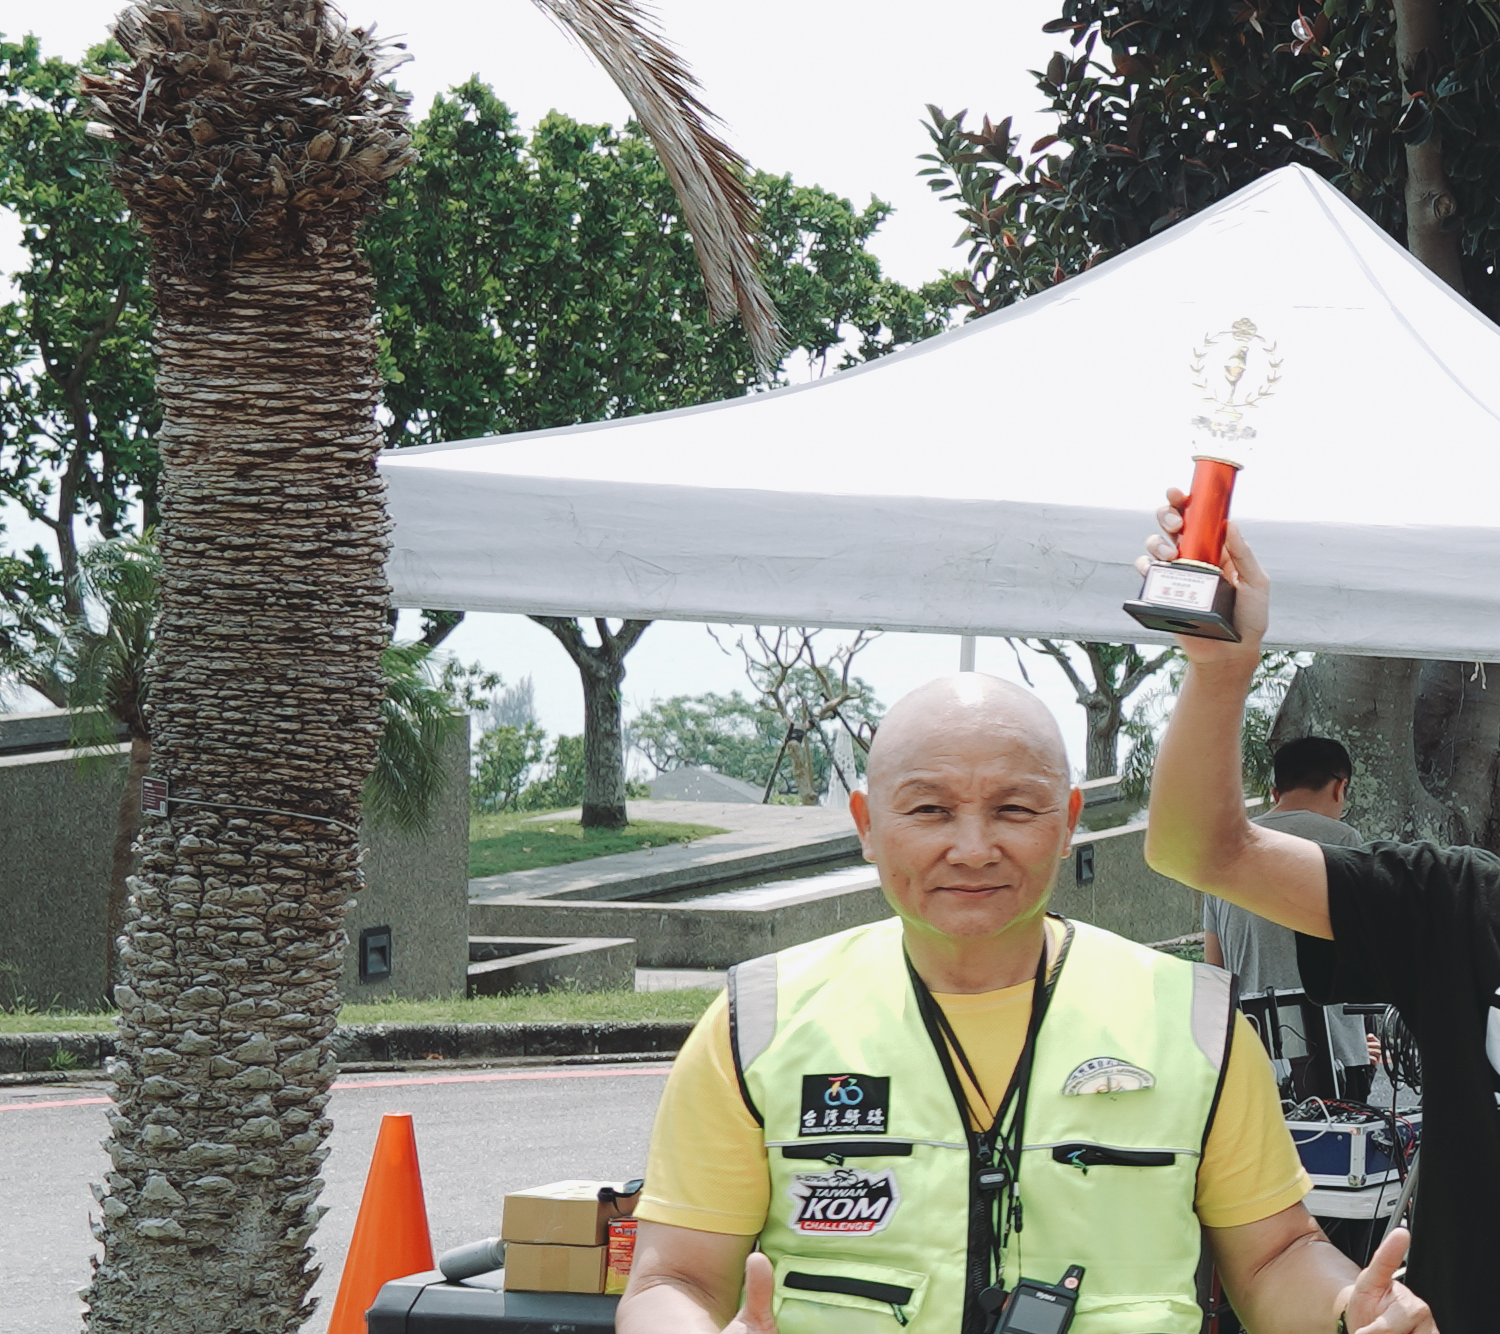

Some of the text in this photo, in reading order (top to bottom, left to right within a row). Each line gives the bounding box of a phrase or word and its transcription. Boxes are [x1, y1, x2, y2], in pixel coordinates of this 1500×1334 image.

[814, 1188, 868, 1198] TAIWAN
[802, 1196, 889, 1221] KOM
[802, 1221, 875, 1231] CHALLENGE
